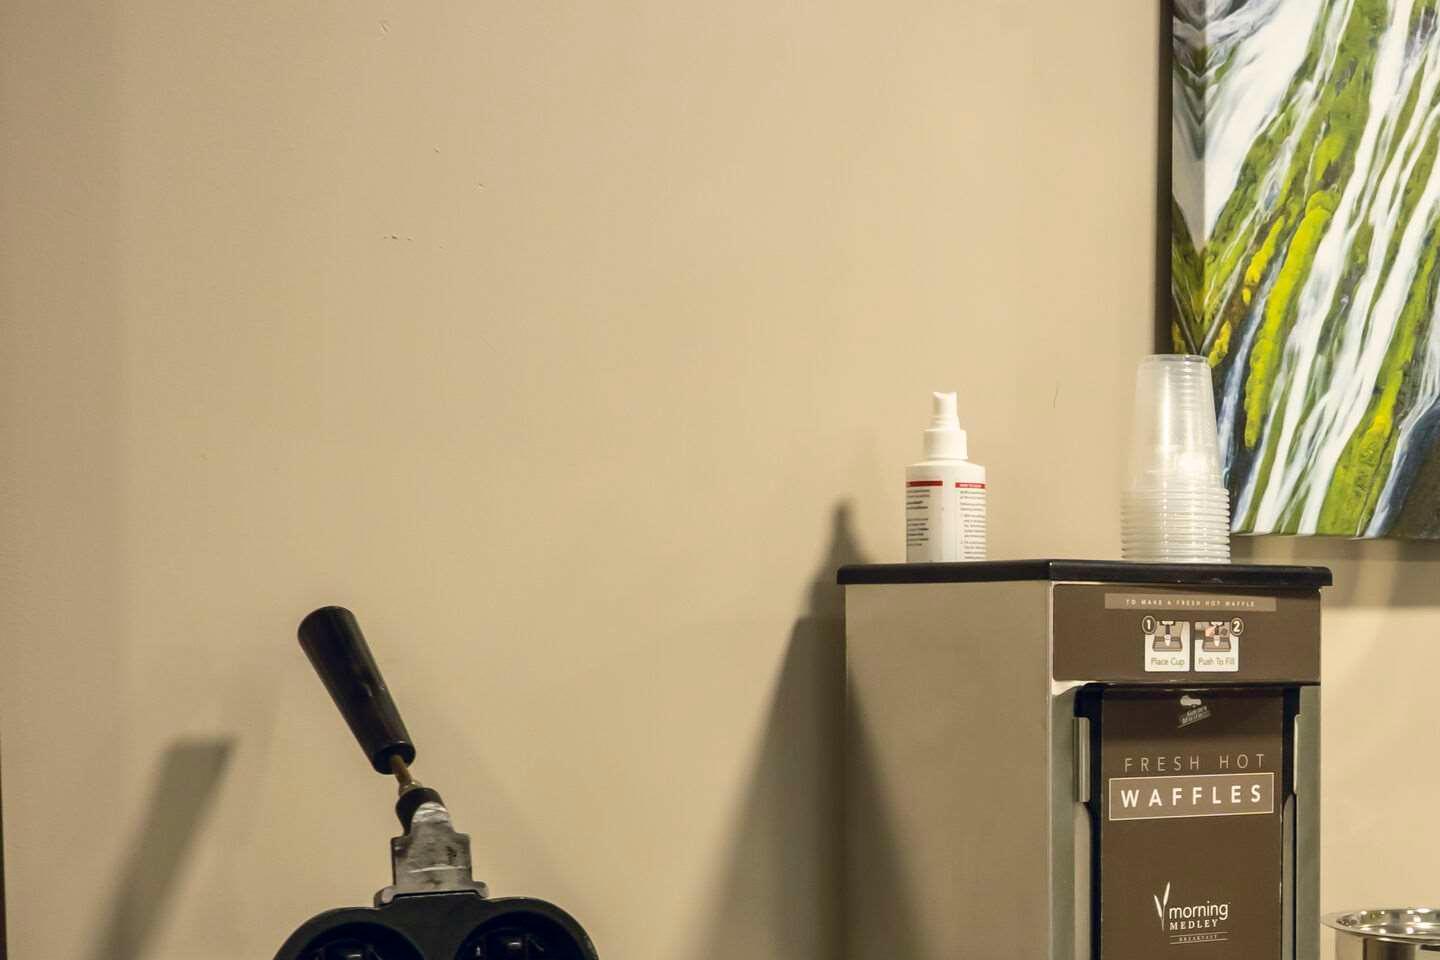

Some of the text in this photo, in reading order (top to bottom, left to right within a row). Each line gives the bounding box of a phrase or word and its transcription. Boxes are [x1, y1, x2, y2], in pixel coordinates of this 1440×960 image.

[1146, 619, 1152, 630] 1
[1233, 620, 1241, 632] 2
[1124, 753, 1265, 772] FRESH HOT
[1120, 784, 1262, 808] WAFFLES
[1169, 900, 1229, 921] morning
[1169, 919, 1218, 931] MEDLEY
